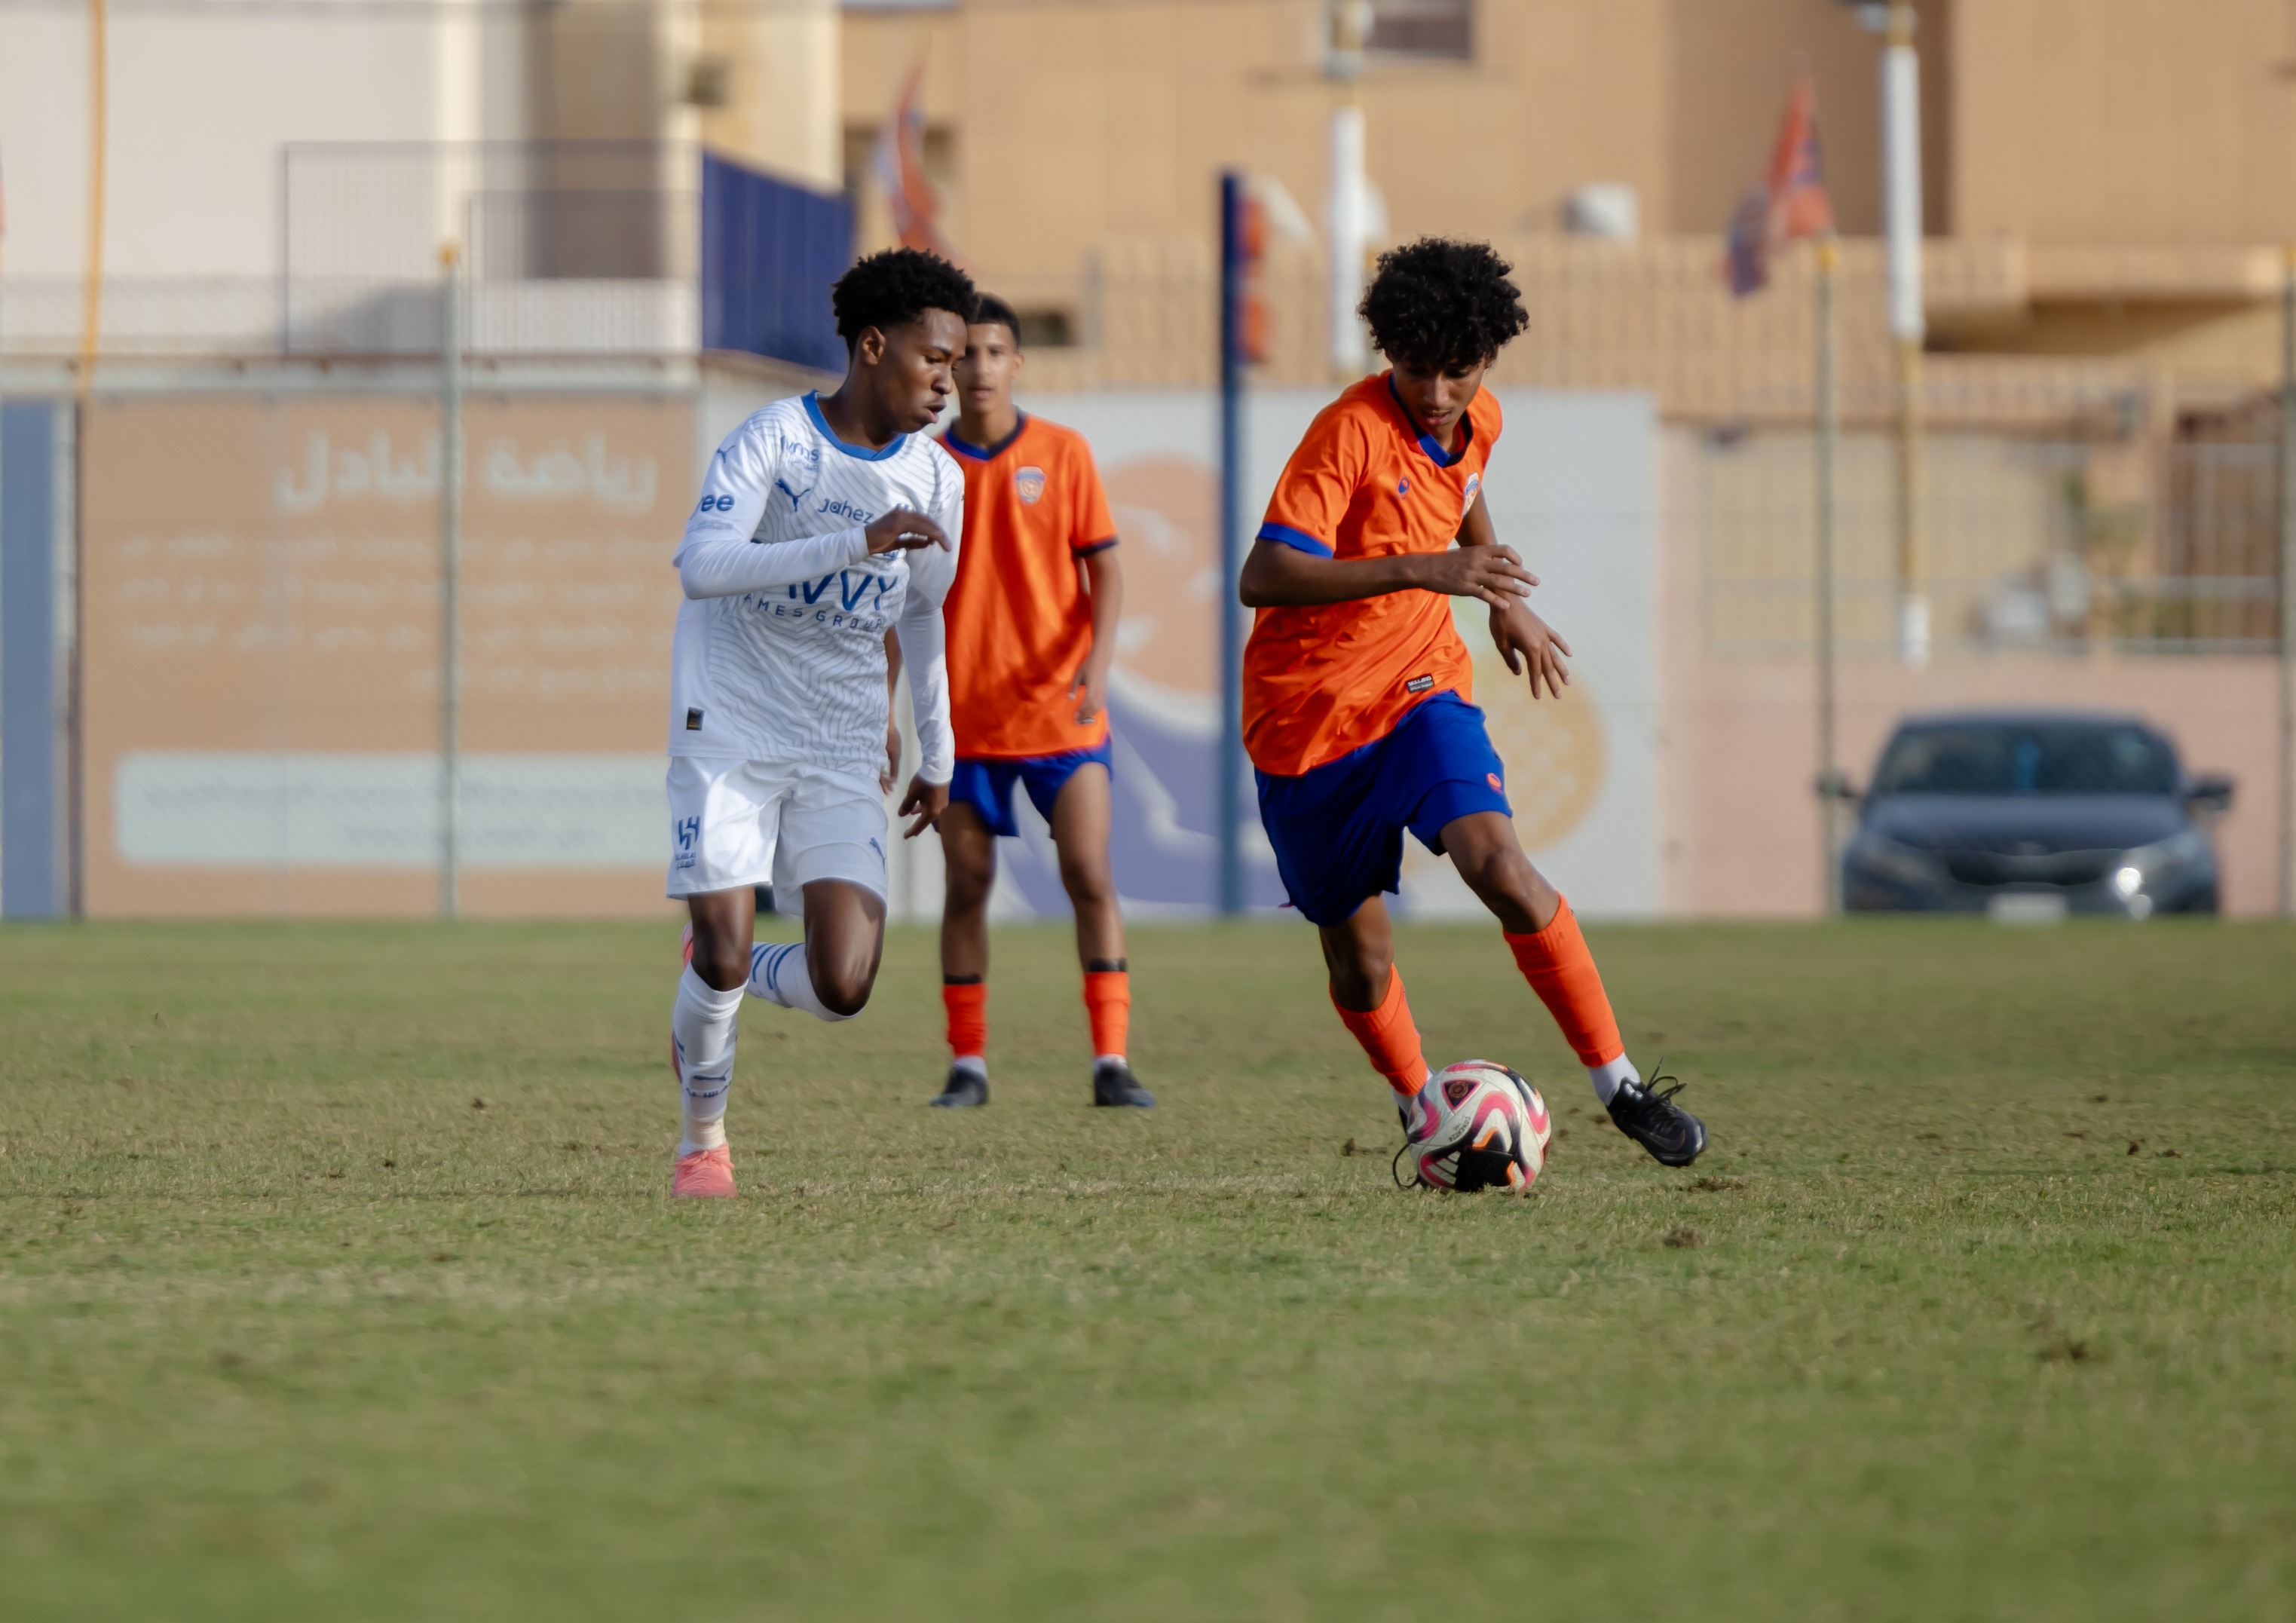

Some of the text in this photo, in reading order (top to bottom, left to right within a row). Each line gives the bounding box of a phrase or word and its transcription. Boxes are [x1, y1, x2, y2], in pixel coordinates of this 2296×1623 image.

[271, 427, 466, 516] لبادل
[743, 593, 803, 617] AMES
[788, 569, 899, 611] VVY
